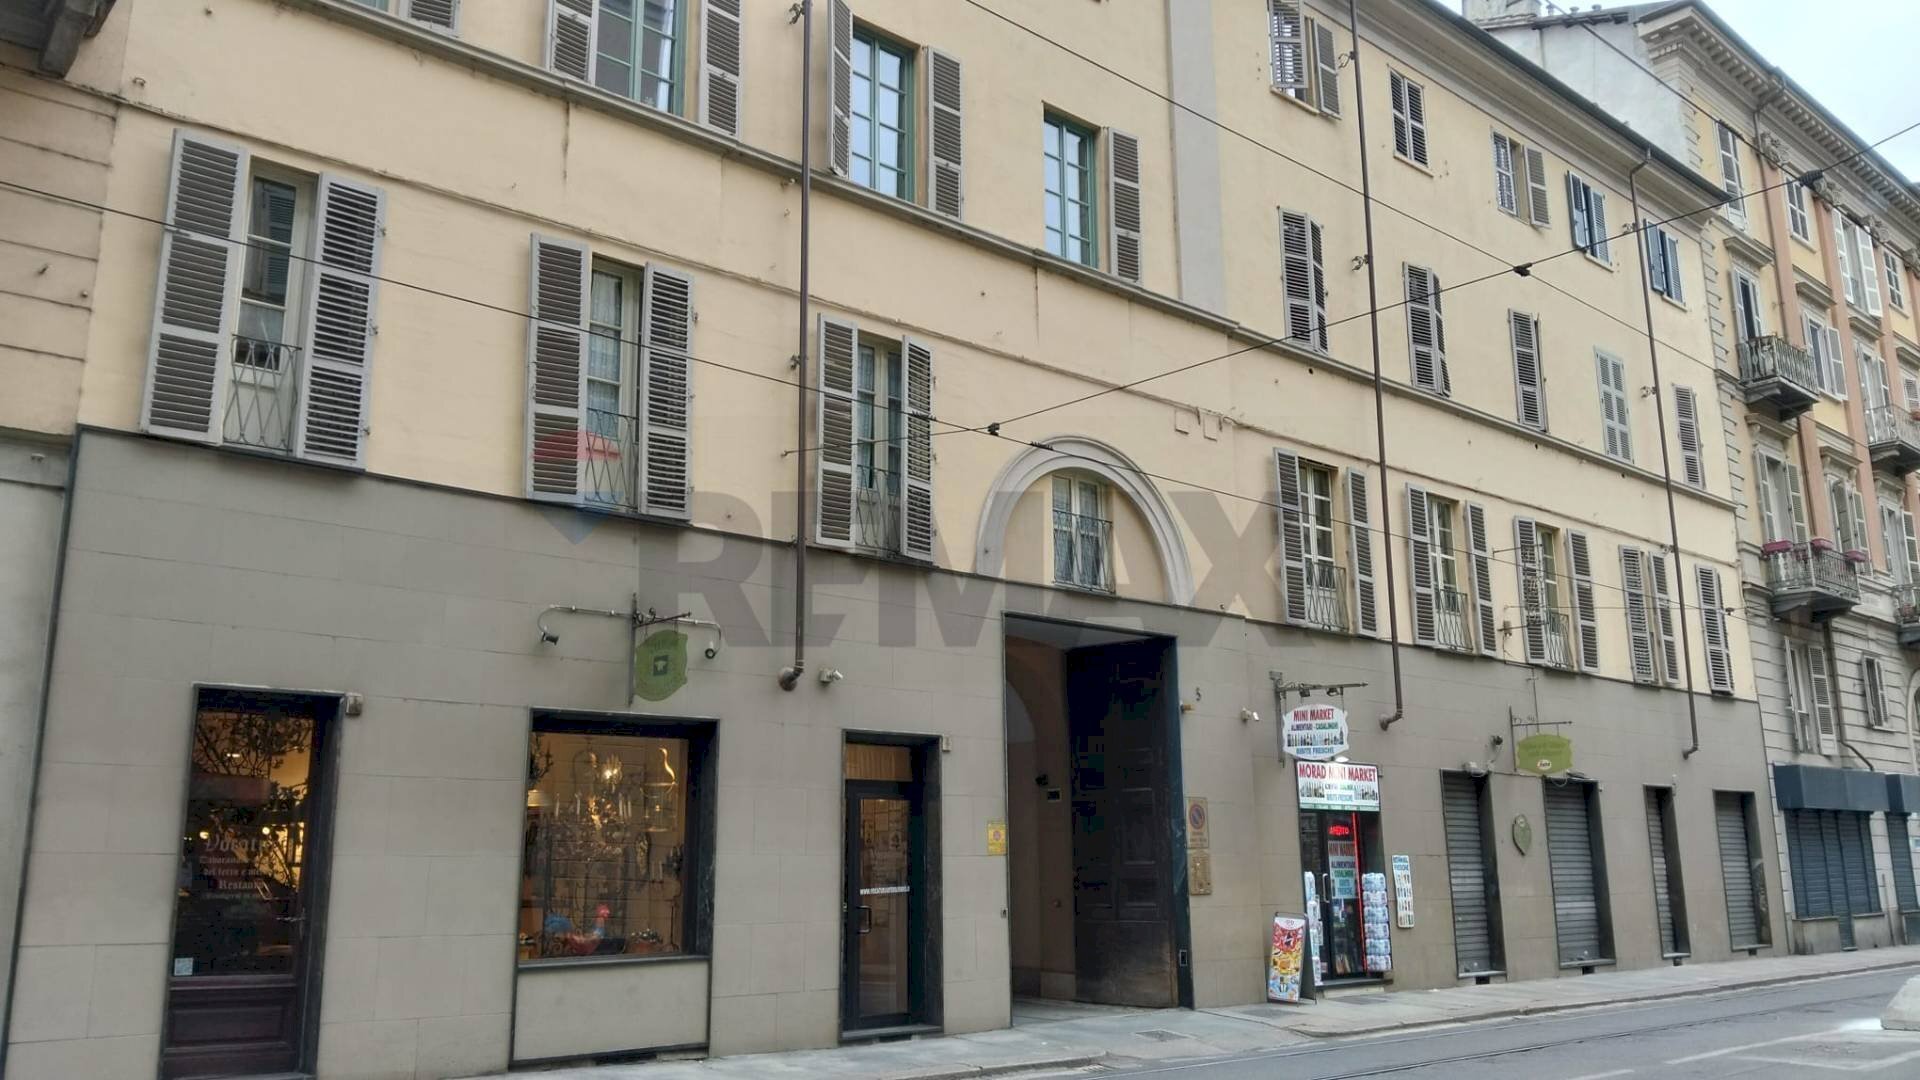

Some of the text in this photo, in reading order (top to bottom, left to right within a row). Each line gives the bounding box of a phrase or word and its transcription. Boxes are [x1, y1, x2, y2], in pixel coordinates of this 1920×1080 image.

[1293, 708, 1334, 722] MINI MARKET
[1299, 764, 1326, 779] MORAD
[1348, 767, 1376, 782] MARKET
